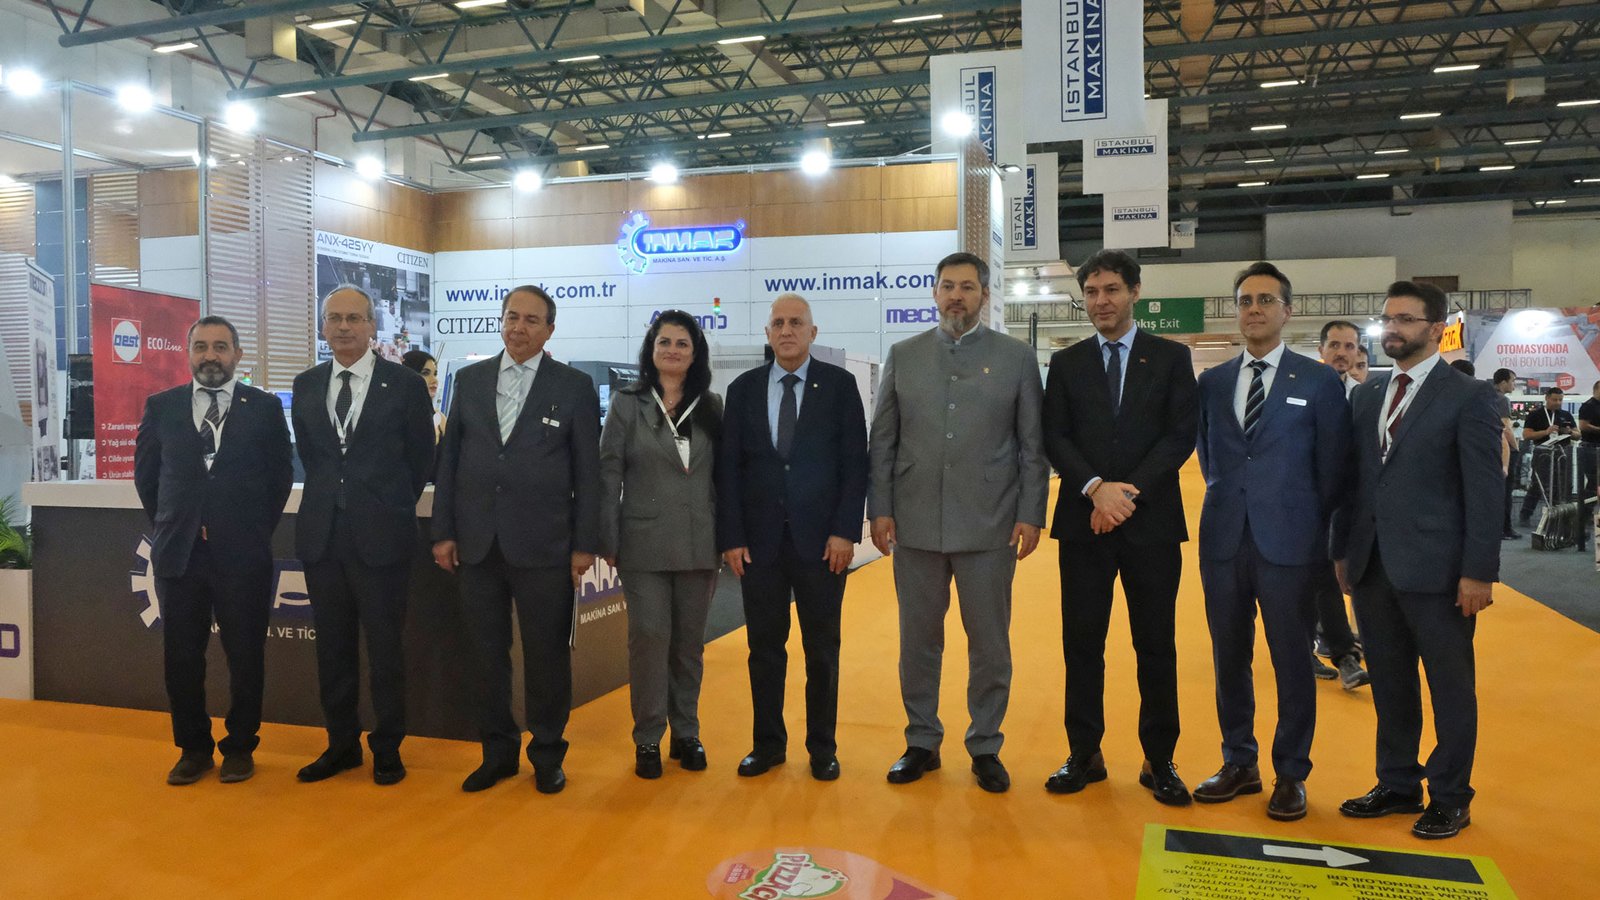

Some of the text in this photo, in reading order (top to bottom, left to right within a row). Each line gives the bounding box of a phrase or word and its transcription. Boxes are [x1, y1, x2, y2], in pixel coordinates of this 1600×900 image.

[1065, 0, 1081, 113] İSTANBU
[980, 82, 993, 160] AKİNA
[1102, 146, 1148, 155] MAKİNA
[1014, 197, 1022, 246] İSTAN
[397, 251, 429, 268] CITIZEN
[446, 281, 617, 302] www.ink.com.tr
[886, 306, 939, 323] mect
[1136, 318, 1180, 331] ıkış Exit
[1496, 344, 1569, 354] OTOMASYONDA
[1520, 356, 1568, 368] BOYUTLAR
[580, 608, 606, 624] MAKİNA
[276, 627, 294, 639] VE
[1184, 864, 1293, 881] AND PRODUCTION
[1192, 859, 1282, 873] TECHNOLOGIES
[1162, 868, 1318, 889] MEASUREMENT SYSTEMS
[1247, 884, 1302, 894] QUALITY
